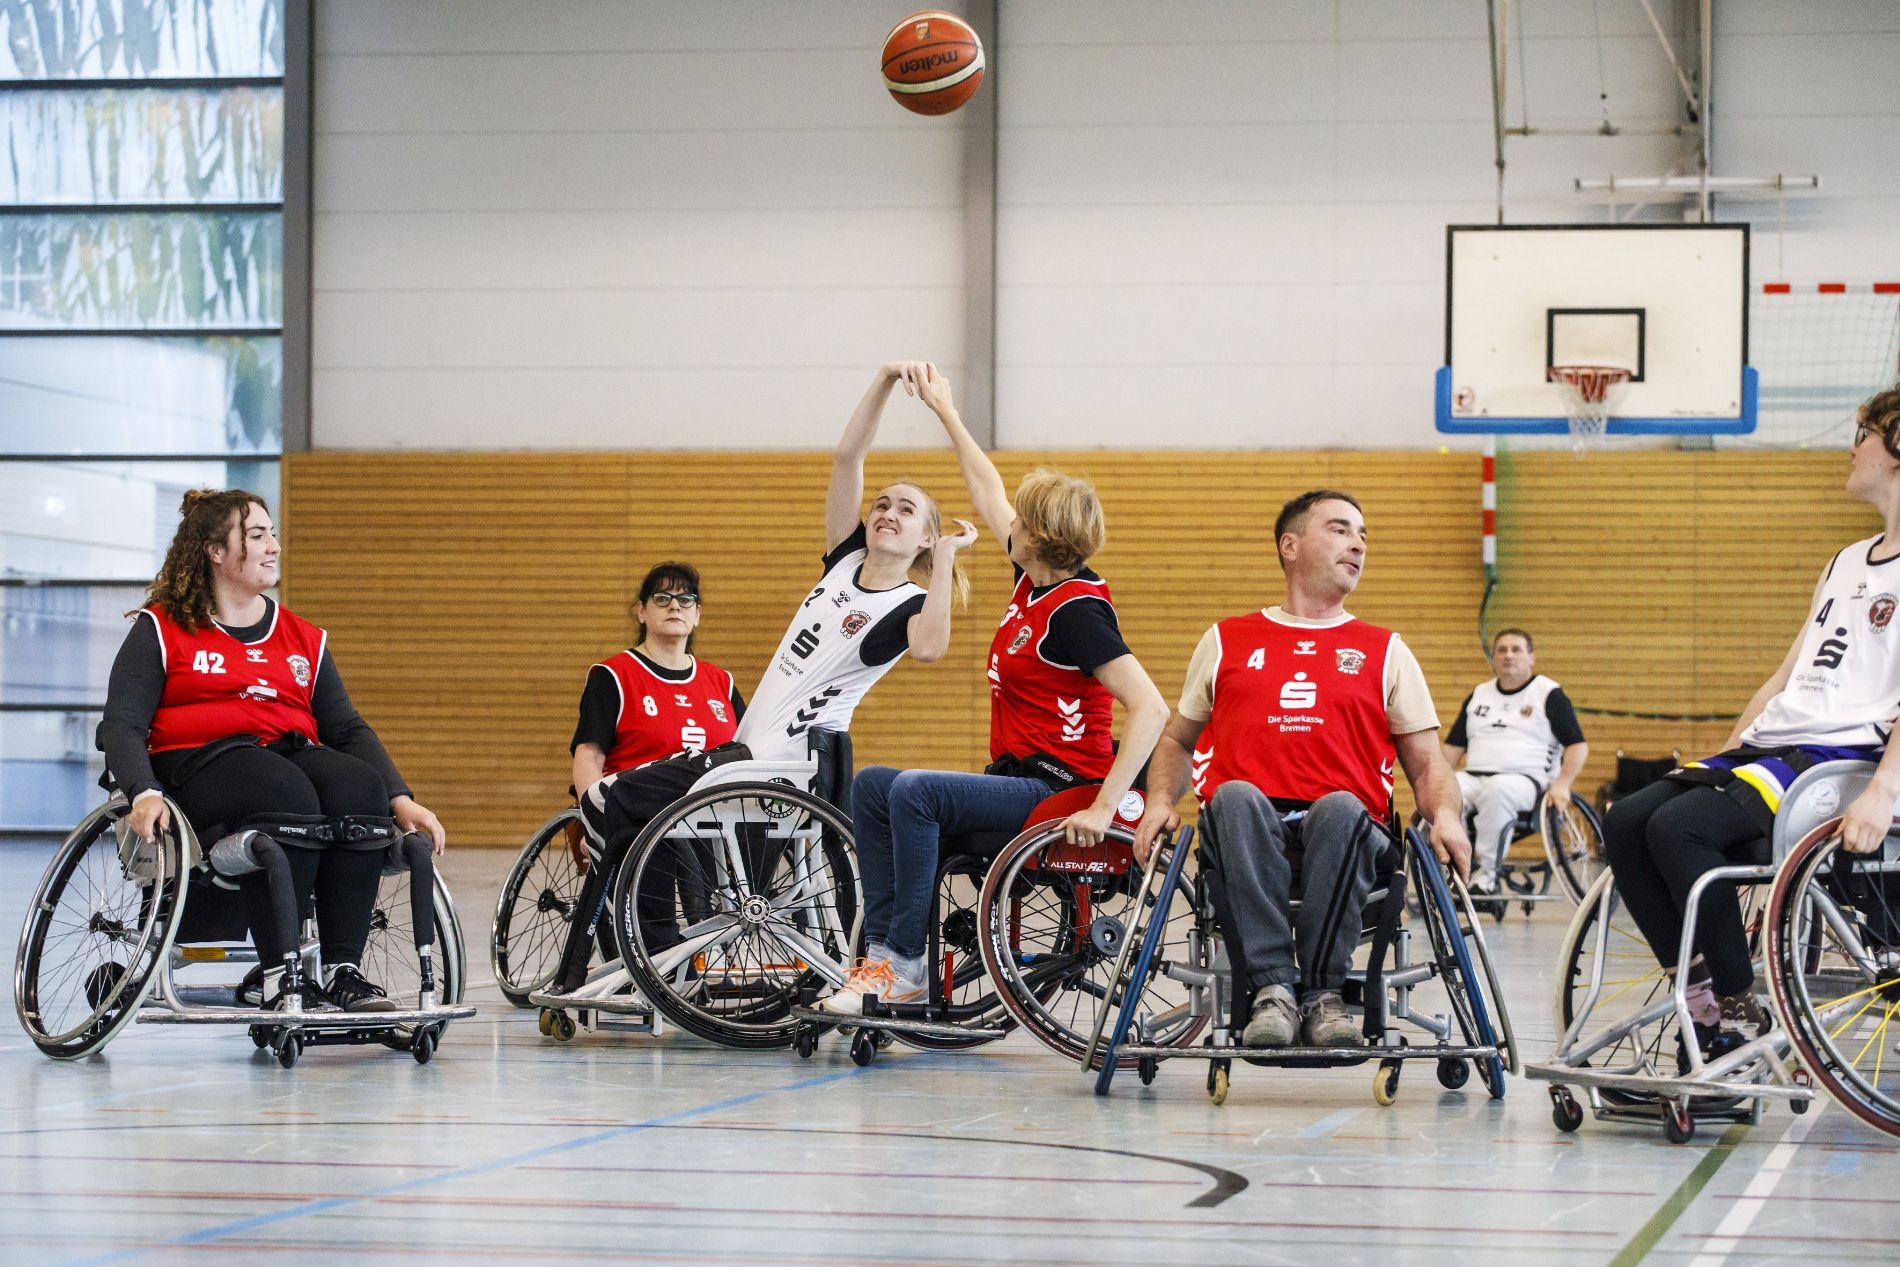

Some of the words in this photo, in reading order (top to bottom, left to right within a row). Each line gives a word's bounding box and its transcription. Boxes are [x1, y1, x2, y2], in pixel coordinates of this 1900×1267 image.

[900, 50, 959, 74] molten
[1814, 598, 1835, 628] 4
[192, 649, 227, 674] 42
[1246, 647, 1266, 670] 4
[642, 694, 659, 717] 8
[1473, 704, 1490, 717] 42
[1267, 715, 1282, 724] Die
[1282, 714, 1325, 725] Sparkasse
[1279, 724, 1312, 733] Bremen
